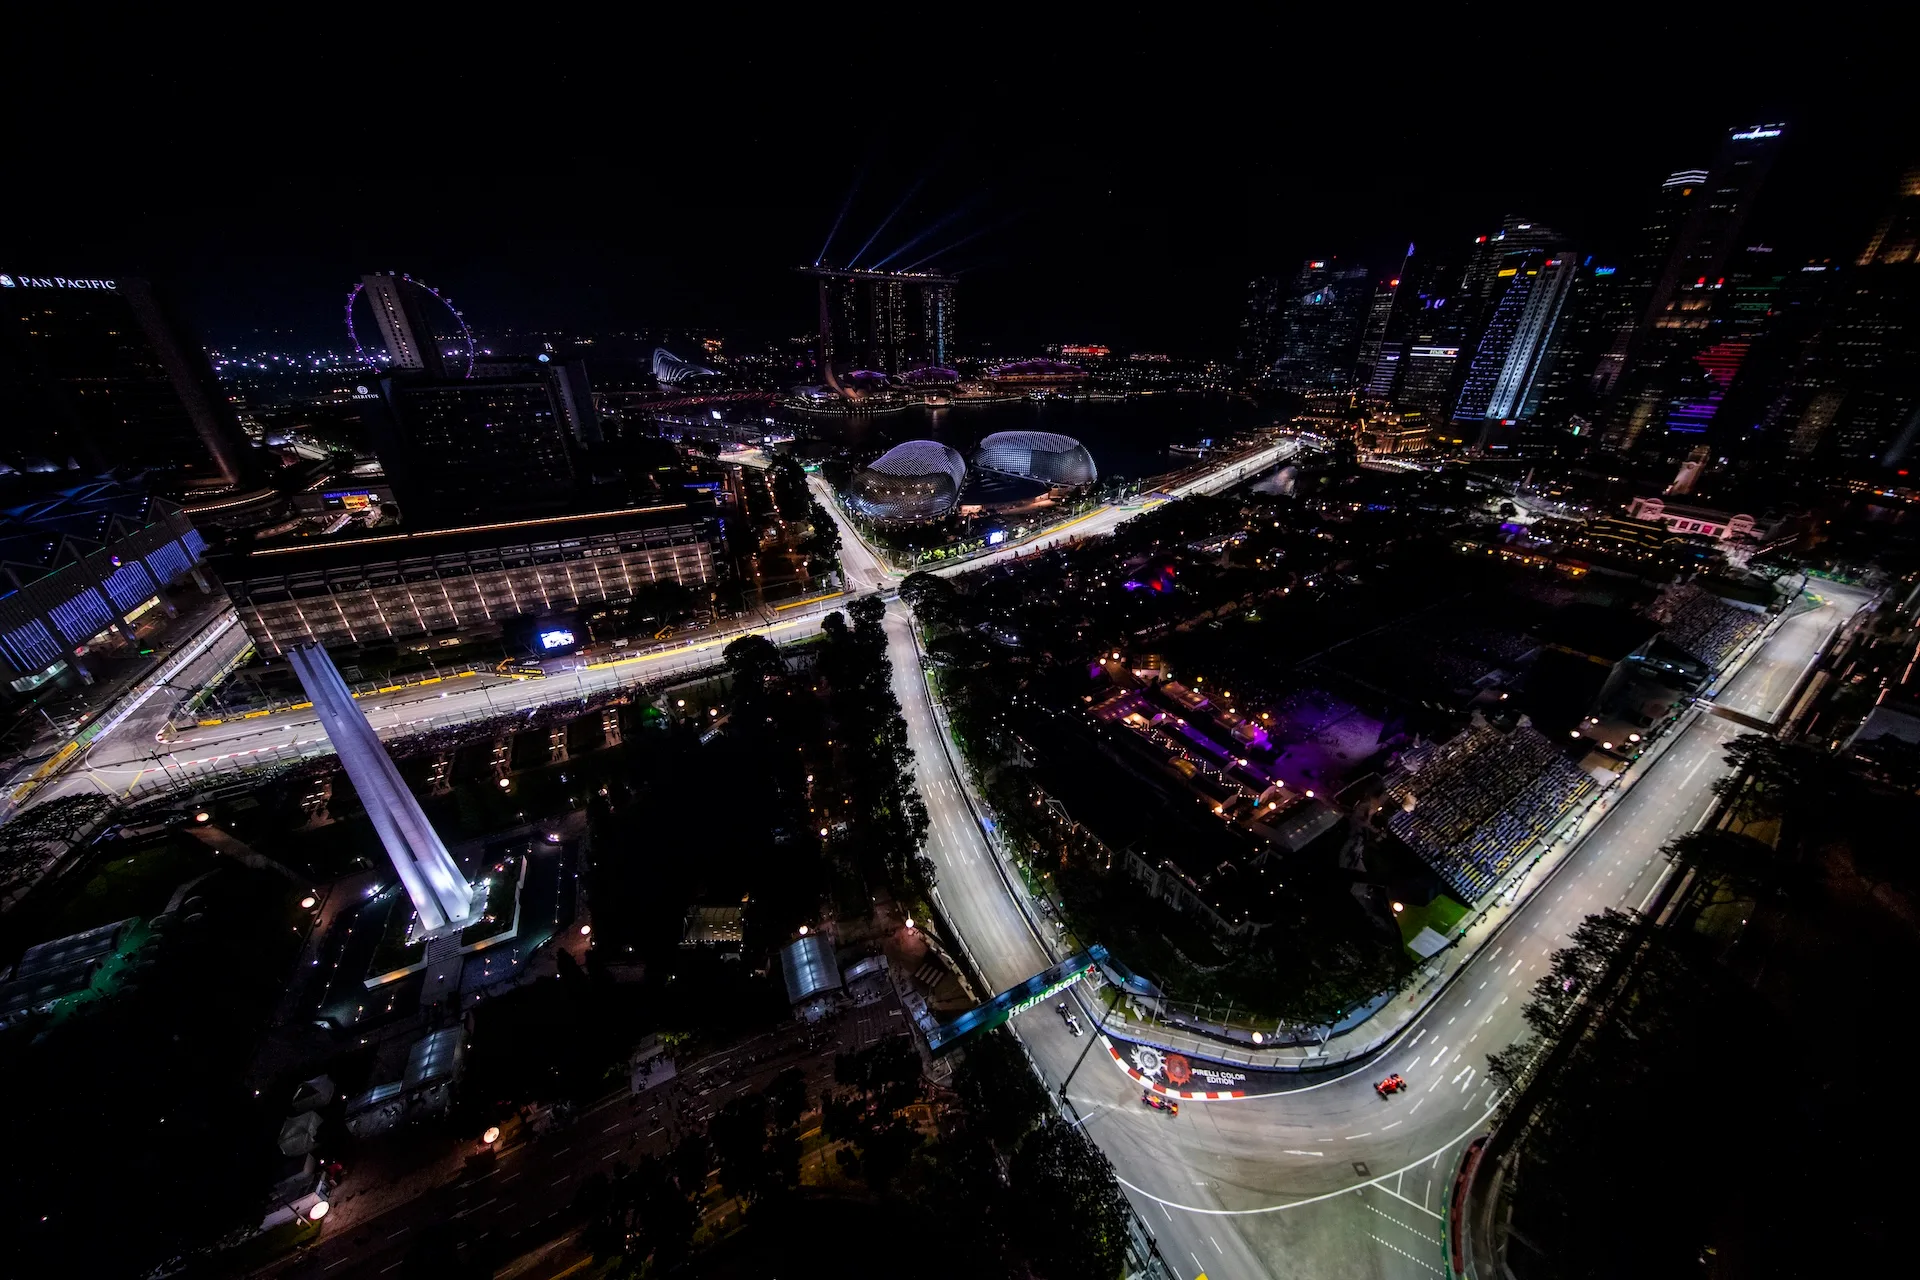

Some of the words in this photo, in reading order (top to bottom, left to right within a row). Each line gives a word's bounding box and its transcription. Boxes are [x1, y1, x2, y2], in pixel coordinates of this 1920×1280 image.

[18, 276, 53, 287] PAN
[54, 277, 117, 289] PACIFIC
[1007, 972, 1082, 1020] Heineken
[1191, 1068, 1219, 1077] PIRELLI
[1220, 1071, 1246, 1081] COLOR
[1206, 1076, 1234, 1086] EDITION
